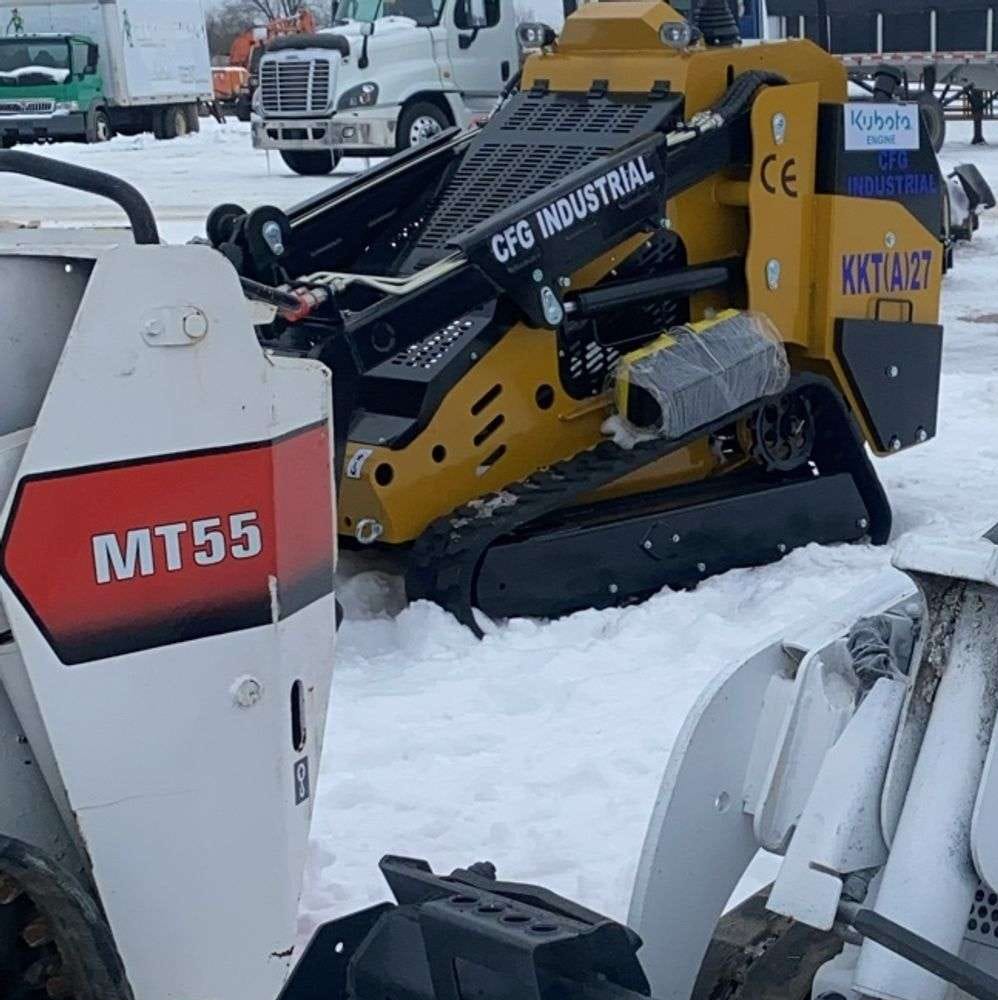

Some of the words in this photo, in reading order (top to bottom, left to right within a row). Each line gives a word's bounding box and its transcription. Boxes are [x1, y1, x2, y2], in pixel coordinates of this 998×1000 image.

[851, 109, 912, 131] Kubota
[866, 135, 896, 145] ENGINE
[760, 154, 798, 198] CE
[878, 151, 908, 170] CFG
[848, 174, 936, 195] INDUSTRIAL
[491, 220, 535, 263] CFG
[535, 156, 655, 239] INDUSTRIAL
[842, 250, 932, 295] KKT(A)27
[91, 511, 263, 584] MT55
